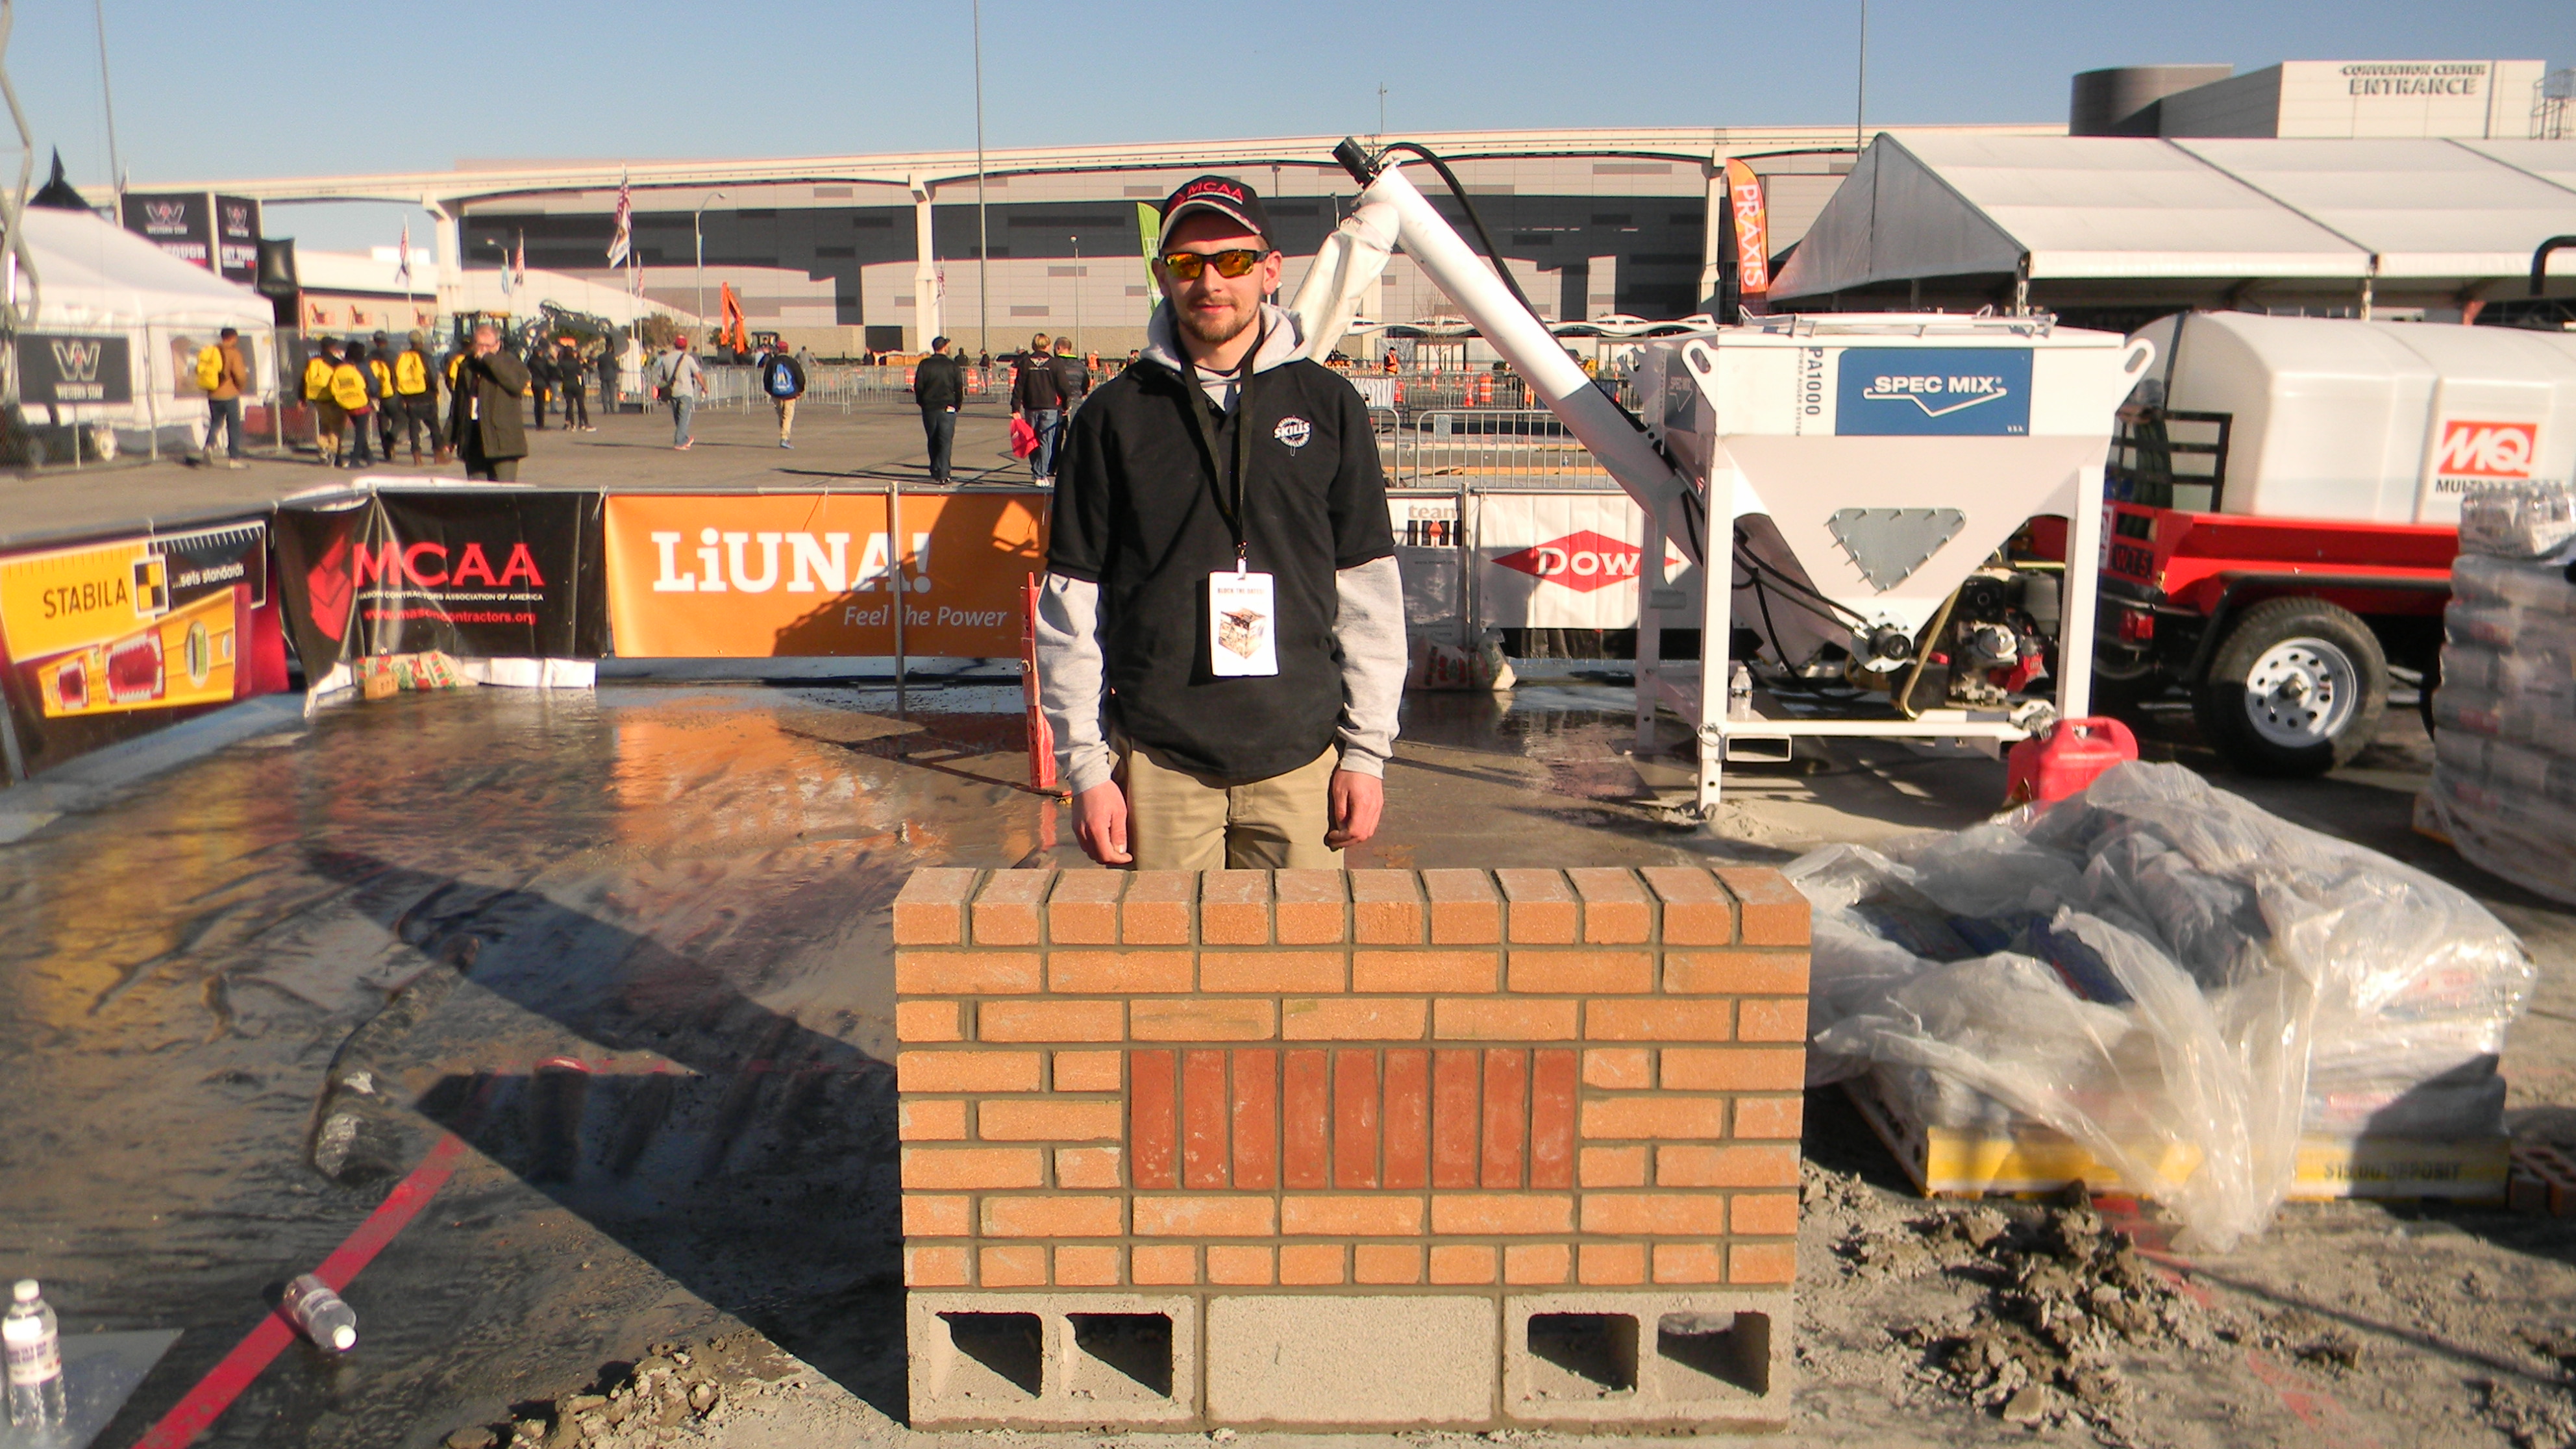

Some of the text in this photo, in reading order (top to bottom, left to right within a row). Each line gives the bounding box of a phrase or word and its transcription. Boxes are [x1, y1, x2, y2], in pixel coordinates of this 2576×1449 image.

[2340, 64, 2486, 75] CONVENTION CENTER
[2349, 77, 2477, 95] ENTRANCE
[1188, 182, 1243, 202] MCAA
[1735, 184, 1765, 288] PRAXIS
[1805, 347, 1823, 415] PA1000
[1874, 376, 1994, 393] SPEC MIX
[56, 384, 104, 400] WESTERN STAR
[1274, 422, 1311, 439] SKILLS
[2439, 426, 2533, 473] MQ
[353, 542, 545, 587] MCAA
[651, 527, 931, 593] LiUNA!
[203, 563, 245, 584] standards
[43, 578, 128, 619] STABILA
[384, 590, 444, 601] CONTRACTORS
[844, 604, 1008, 627] Feel he Power
